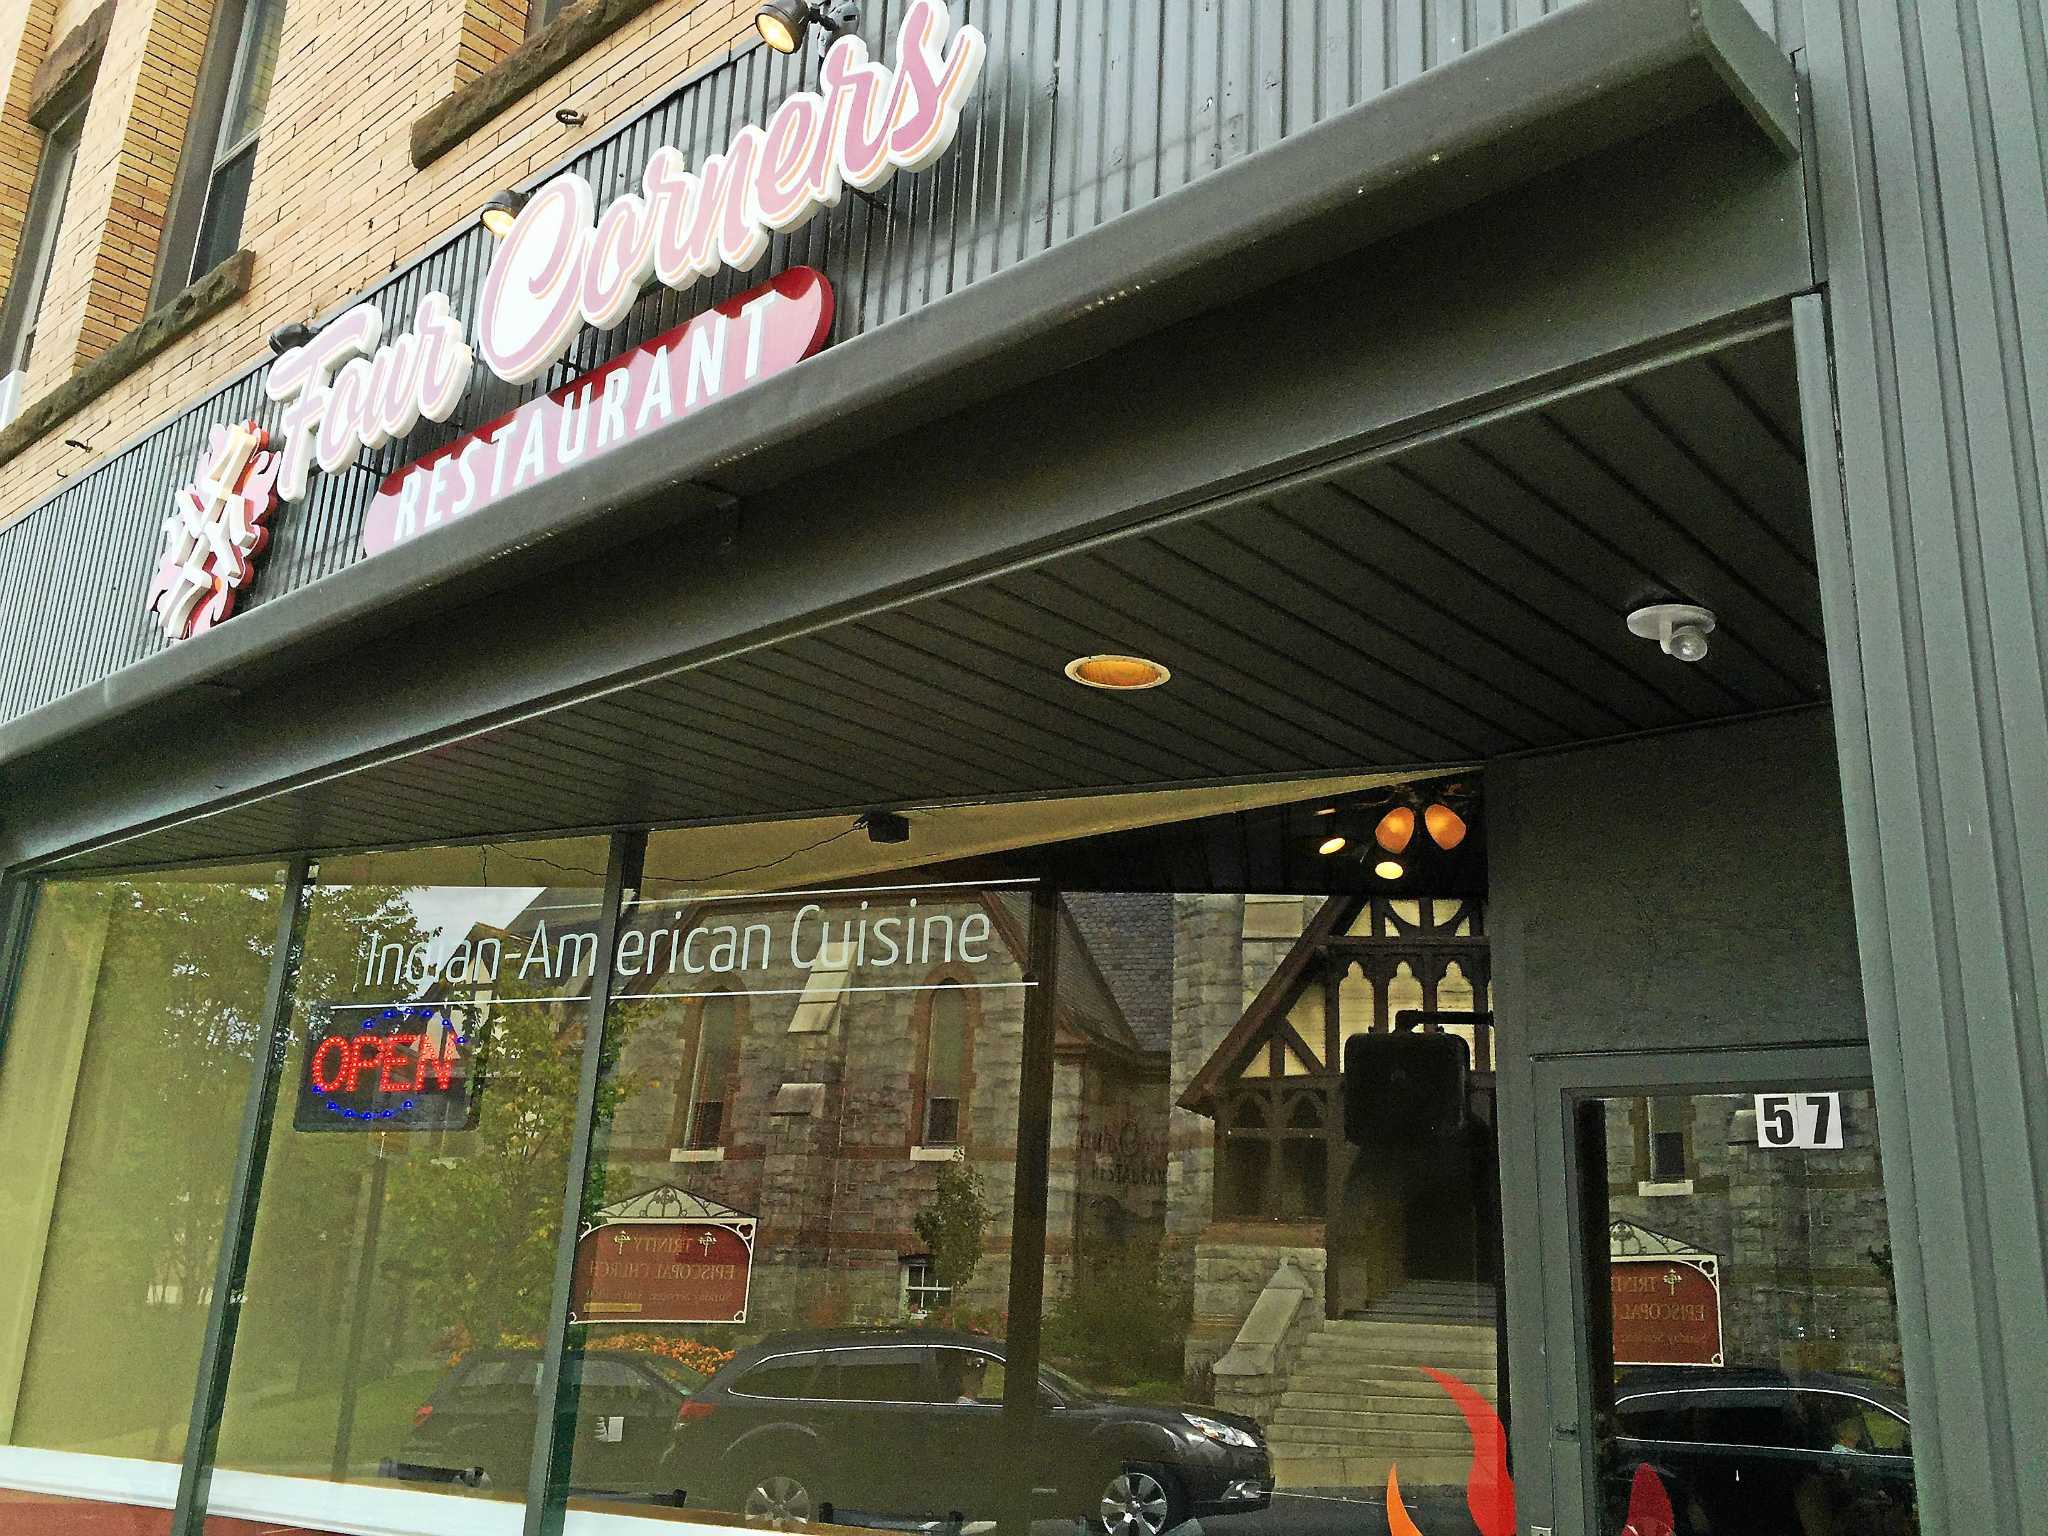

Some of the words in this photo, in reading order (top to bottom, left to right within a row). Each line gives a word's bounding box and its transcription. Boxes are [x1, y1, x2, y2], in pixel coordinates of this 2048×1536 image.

[266, 290, 473, 502] Four
[478, 0, 986, 385] Corners
[393, 289, 782, 543] RESTAURANT
[789, 897, 991, 970] Cuisine
[312, 1034, 457, 1092] OPEN
[1763, 1096, 1831, 1145] 57
